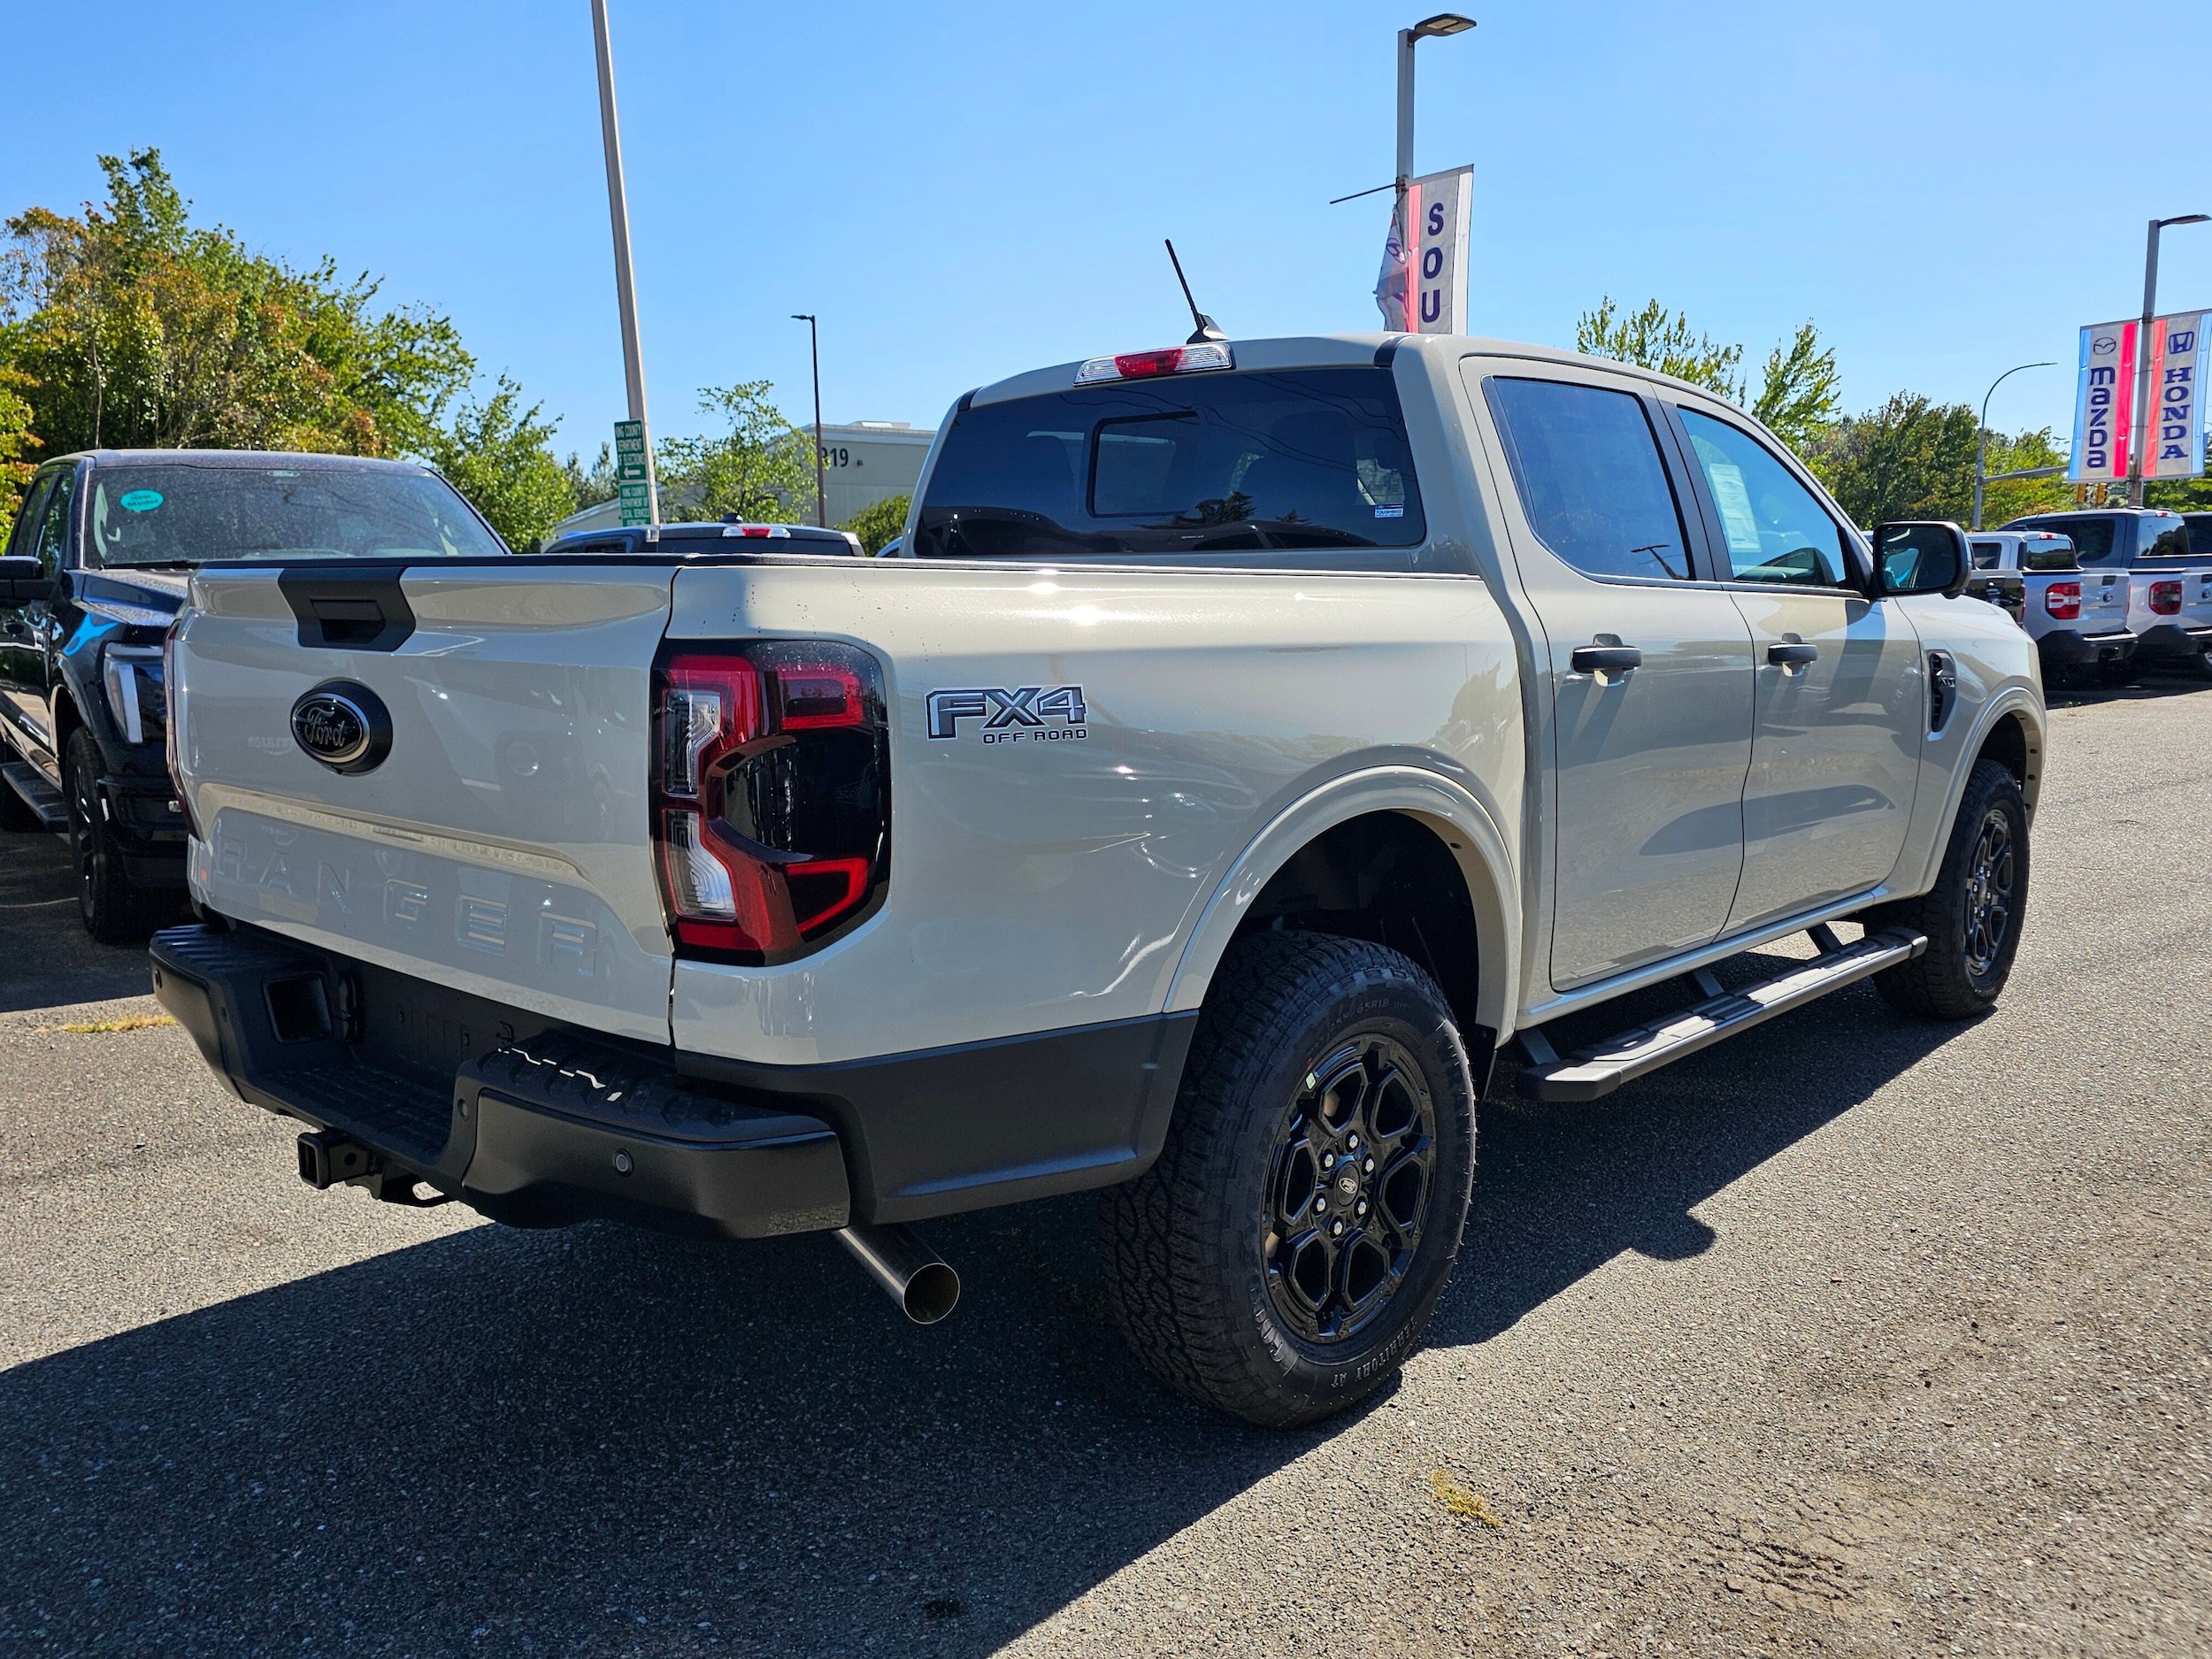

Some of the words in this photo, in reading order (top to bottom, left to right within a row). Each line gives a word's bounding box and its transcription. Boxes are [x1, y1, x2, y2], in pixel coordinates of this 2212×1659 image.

[1421, 202, 1445, 324] SOU
[2160, 365, 2193, 460] HONDA
[304, 706, 346, 748] Ford
[925, 685, 1087, 740] FX4
[983, 732, 1025, 744] OFF
[1033, 728, 1087, 742] ROAD
[215, 836, 597, 977] RANGER
[1355, 1316, 1417, 1382] TERRITORY
[1331, 1372, 1348, 1388] AT
